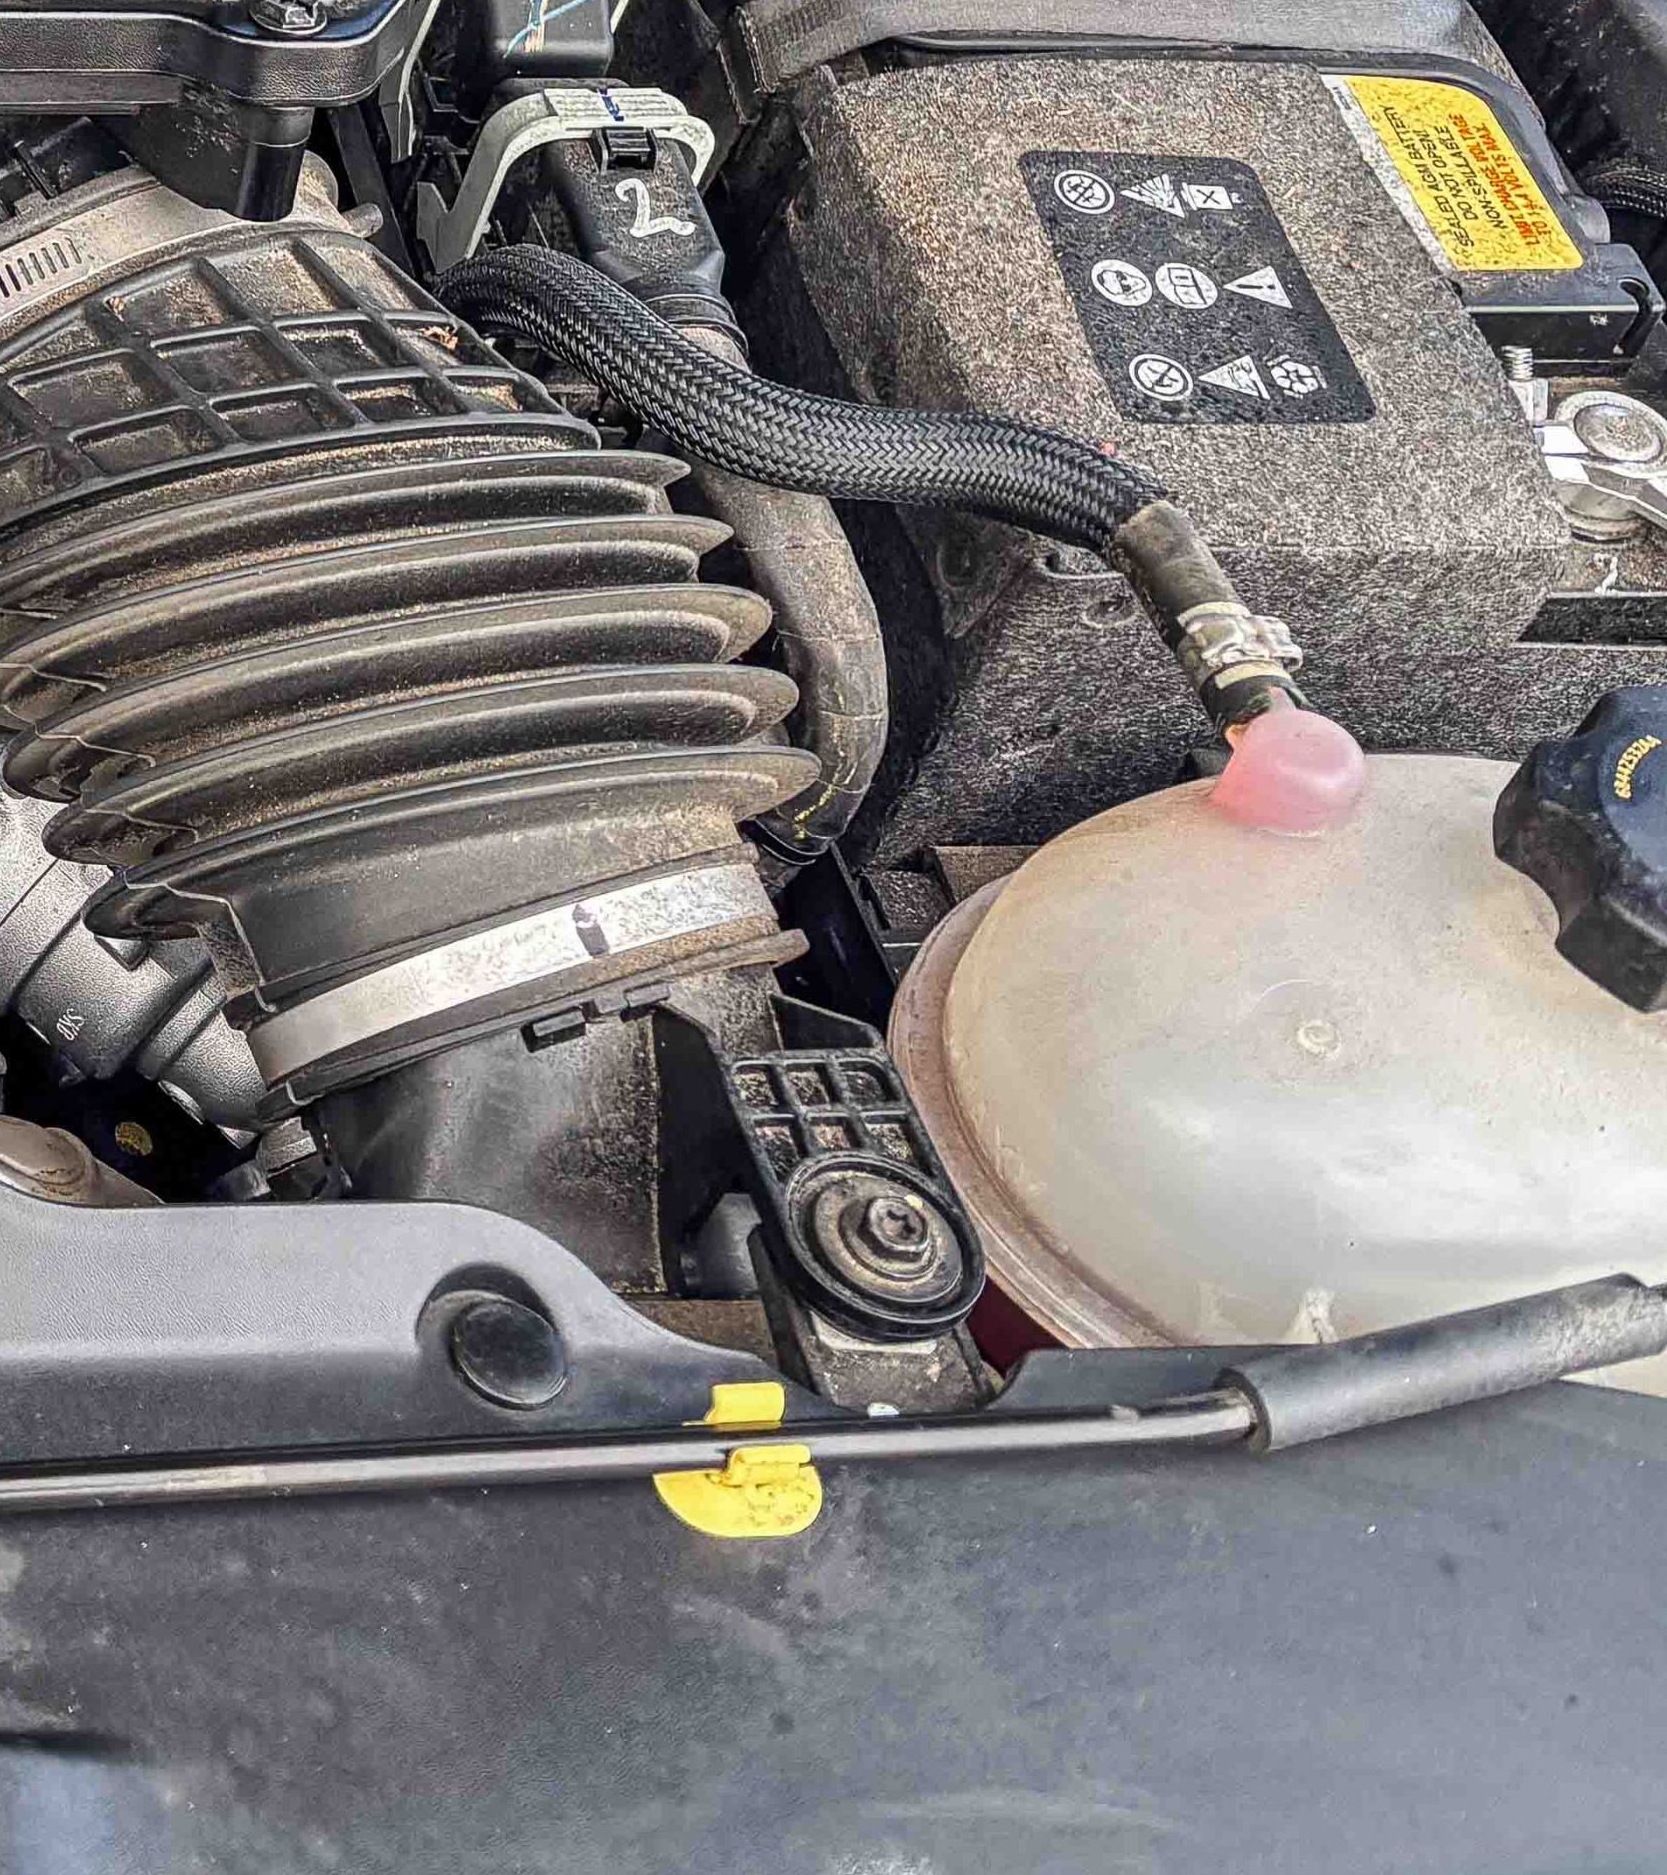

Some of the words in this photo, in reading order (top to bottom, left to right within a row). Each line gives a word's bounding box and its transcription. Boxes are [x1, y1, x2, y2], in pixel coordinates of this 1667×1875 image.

[1378, 104, 1424, 159] BATTERY
[1447, 113, 1489, 161] VOLTAGE
[1413, 163, 1443, 191] AGM
[1432, 125, 1507, 228] NON-SPILLABLE
[1438, 172, 1466, 197] NOT
[1479, 165, 1519, 209] CHARGE
[1490, 154, 1525, 190] VOLTS
[615, 177, 696, 238] 2
[1430, 195, 1476, 246] SEALED
[1455, 202, 1479, 219] DO
[1531, 221, 1552, 234] TO
